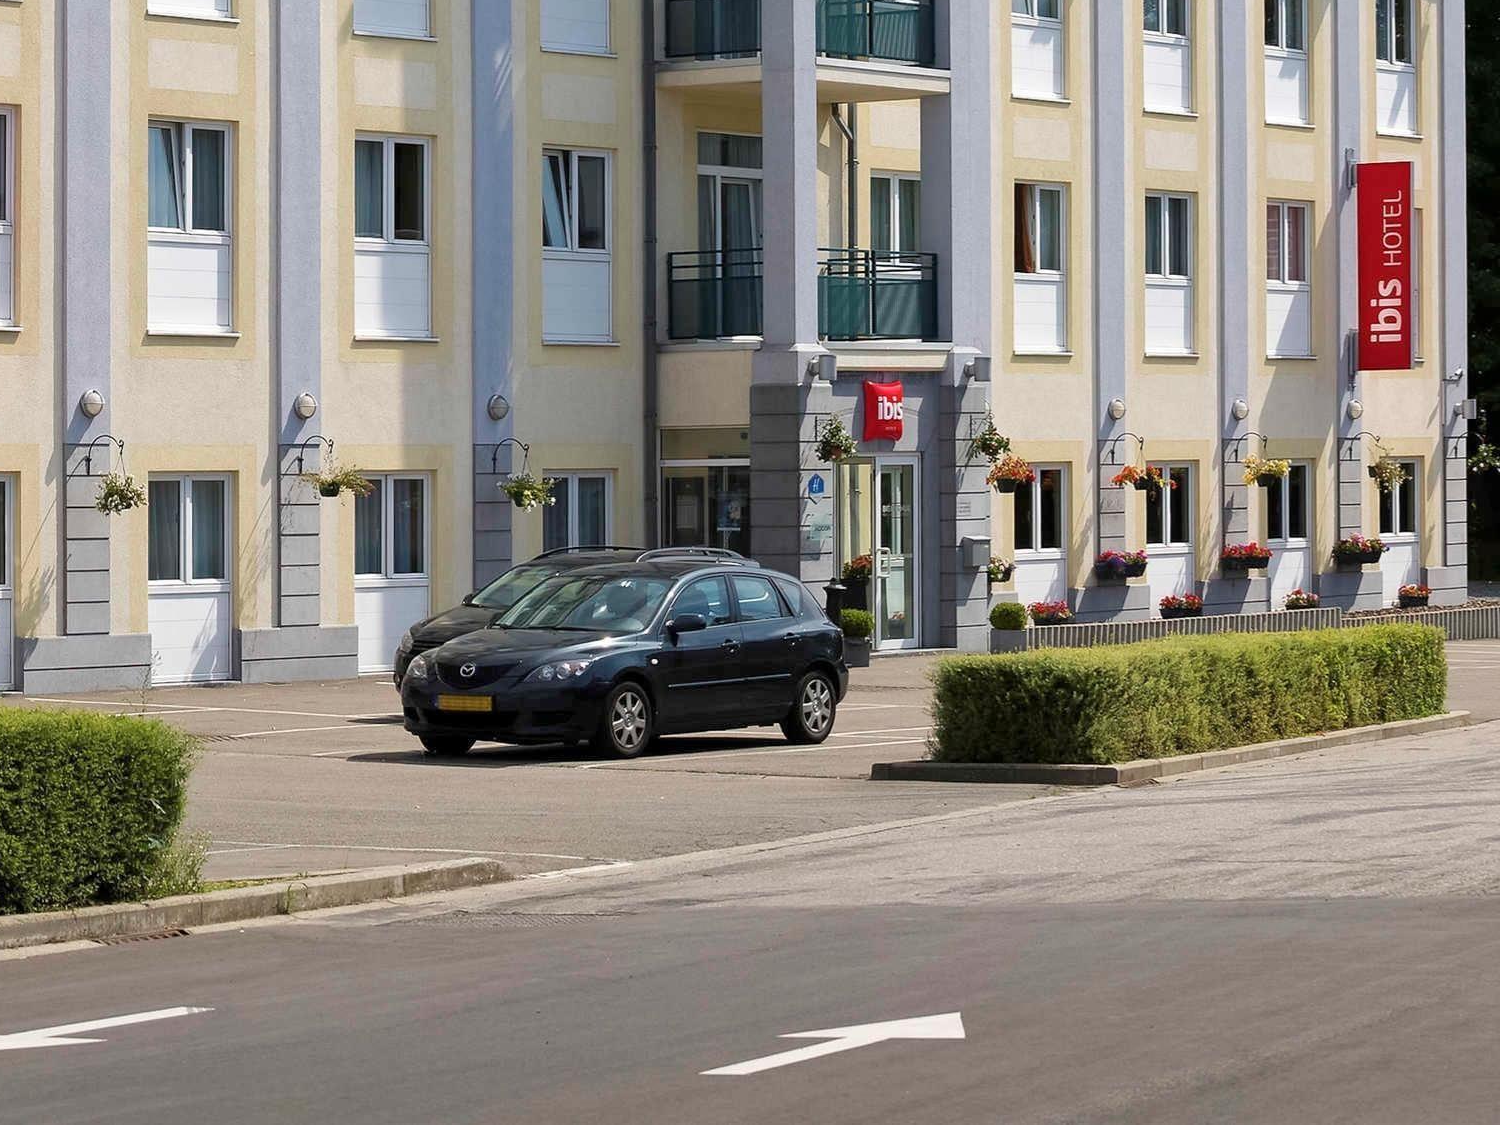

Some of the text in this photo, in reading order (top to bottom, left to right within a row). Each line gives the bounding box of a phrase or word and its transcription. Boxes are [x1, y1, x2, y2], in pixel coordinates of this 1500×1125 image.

[1370, 190, 1402, 343] ibis HOTEL
[877, 395, 904, 420] ibis
